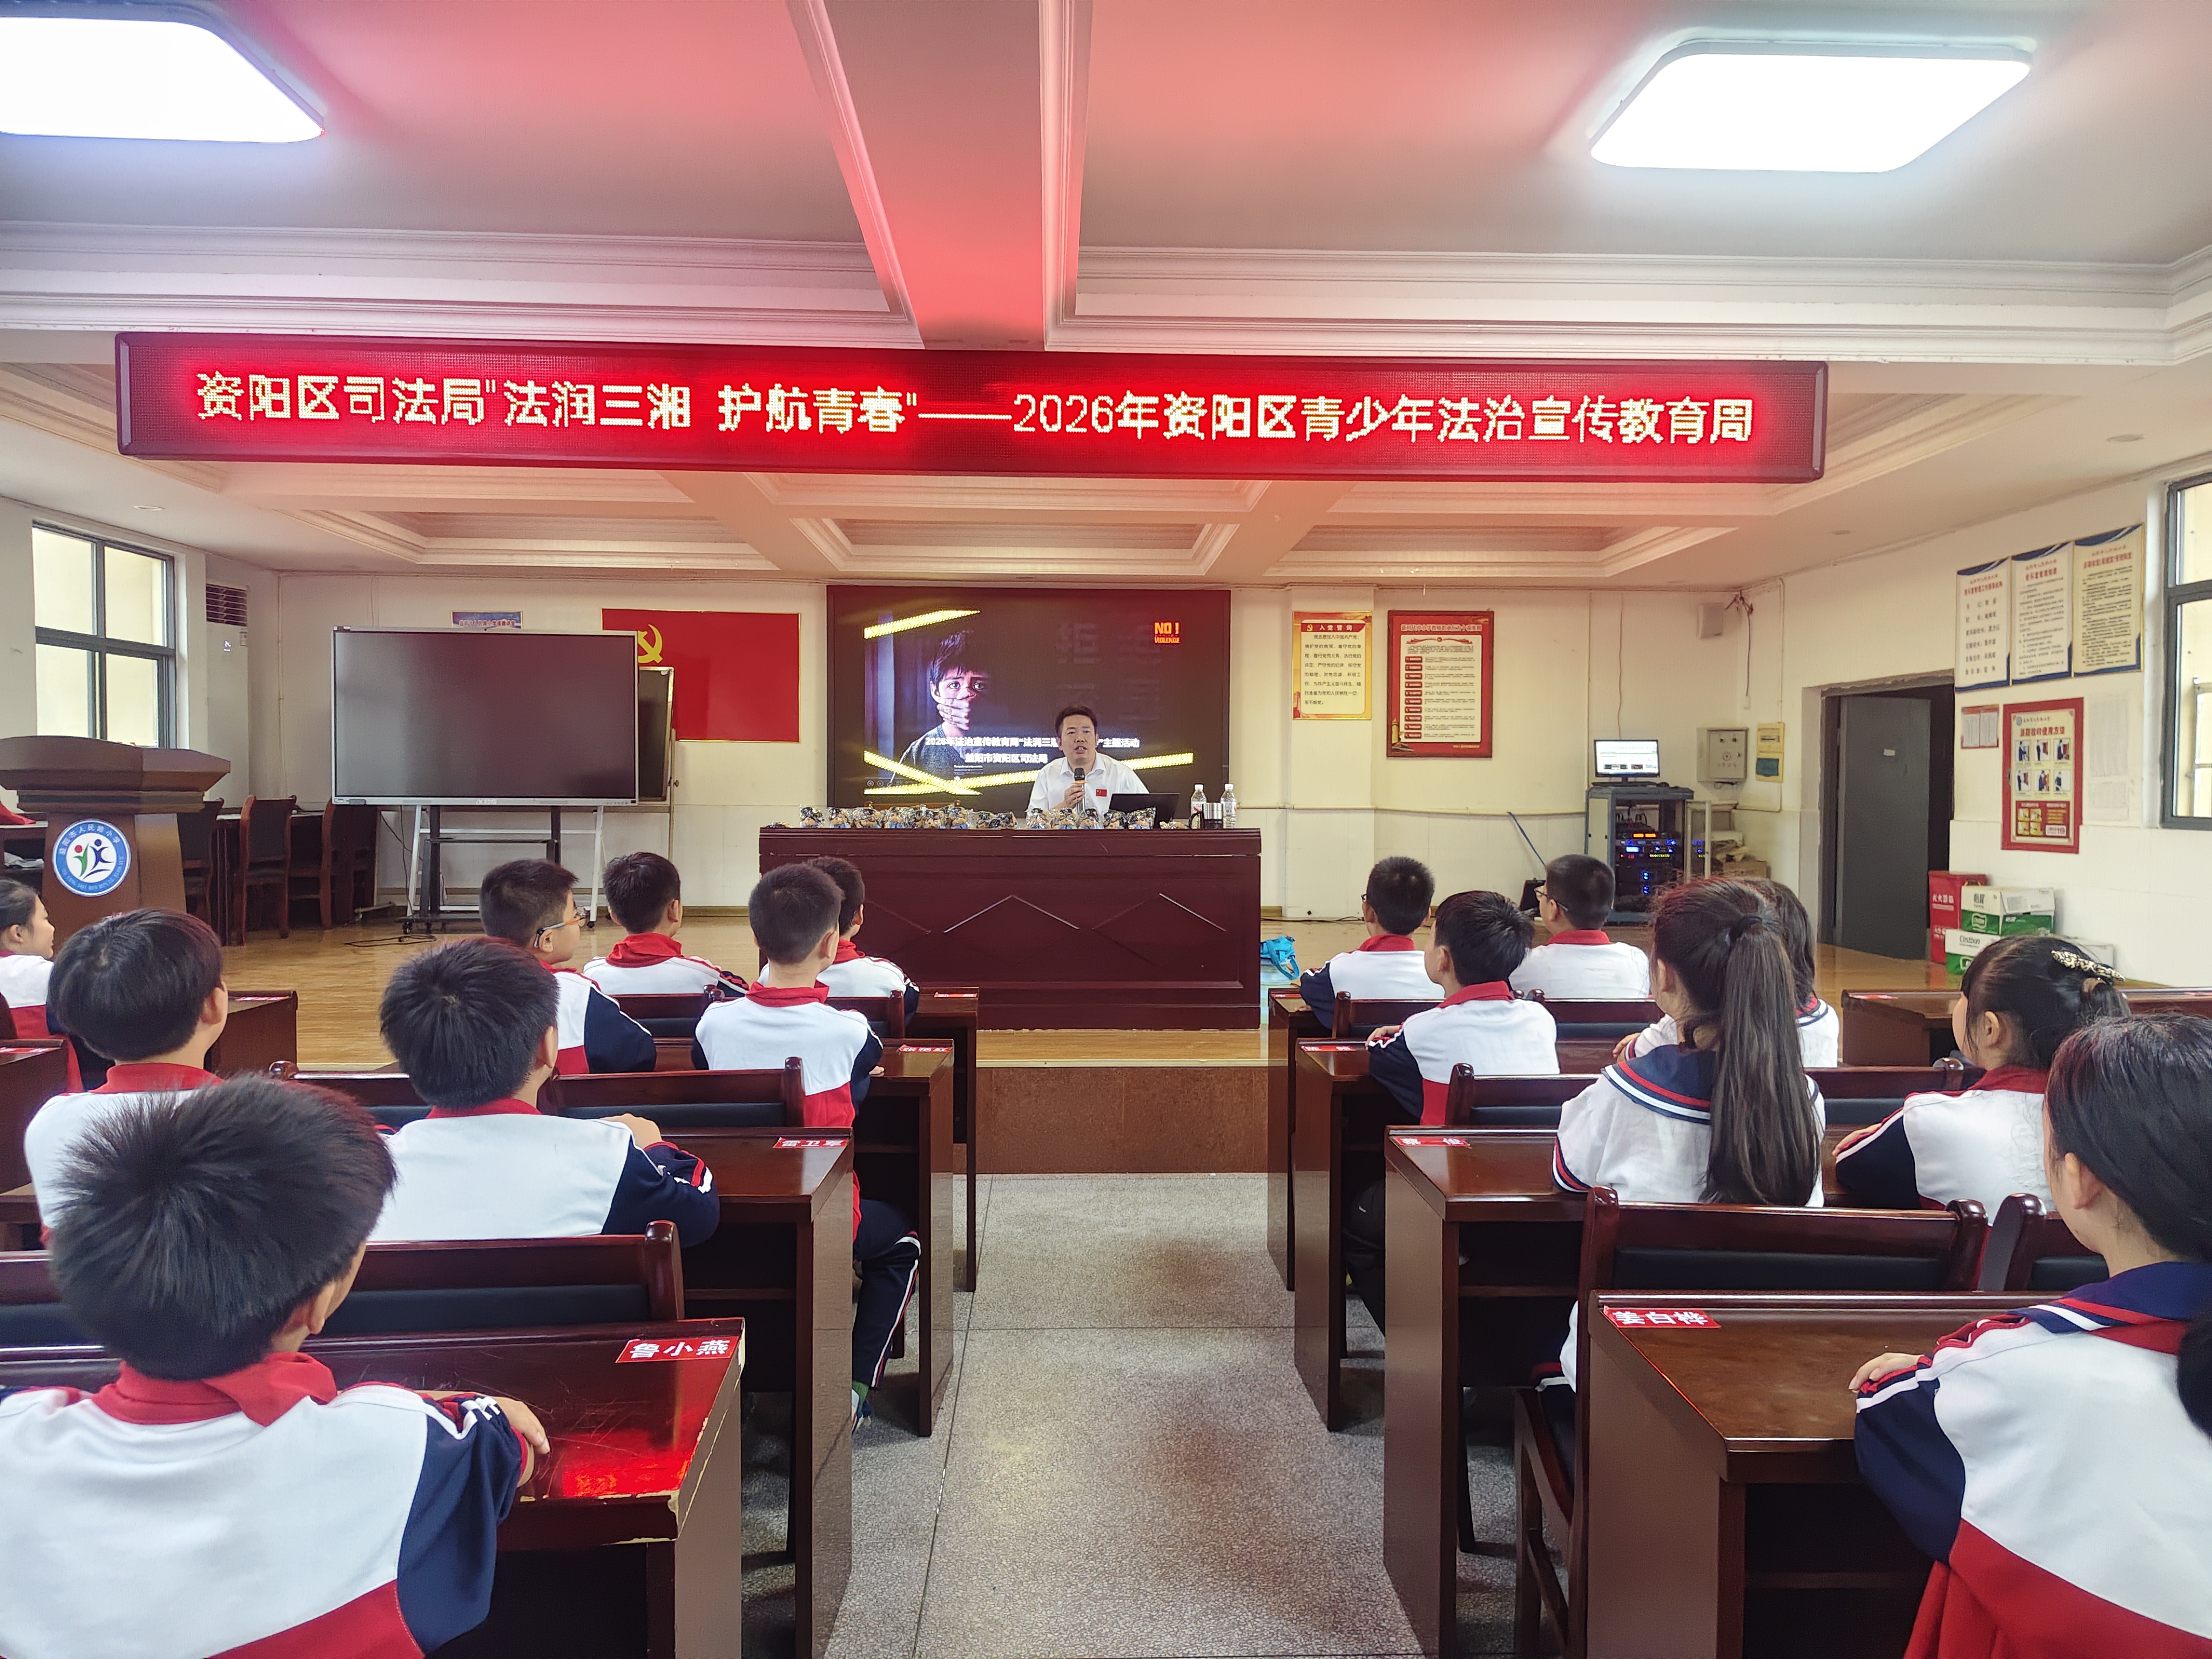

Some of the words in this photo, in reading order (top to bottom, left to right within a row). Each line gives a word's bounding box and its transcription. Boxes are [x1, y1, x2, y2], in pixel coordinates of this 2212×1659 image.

[196, 370, 691, 430] 资阳区司法局"法润三湘
[1612, 1311, 1708, 1325] 姜白桦
[629, 1340, 730, 1359] 鲁小燕
